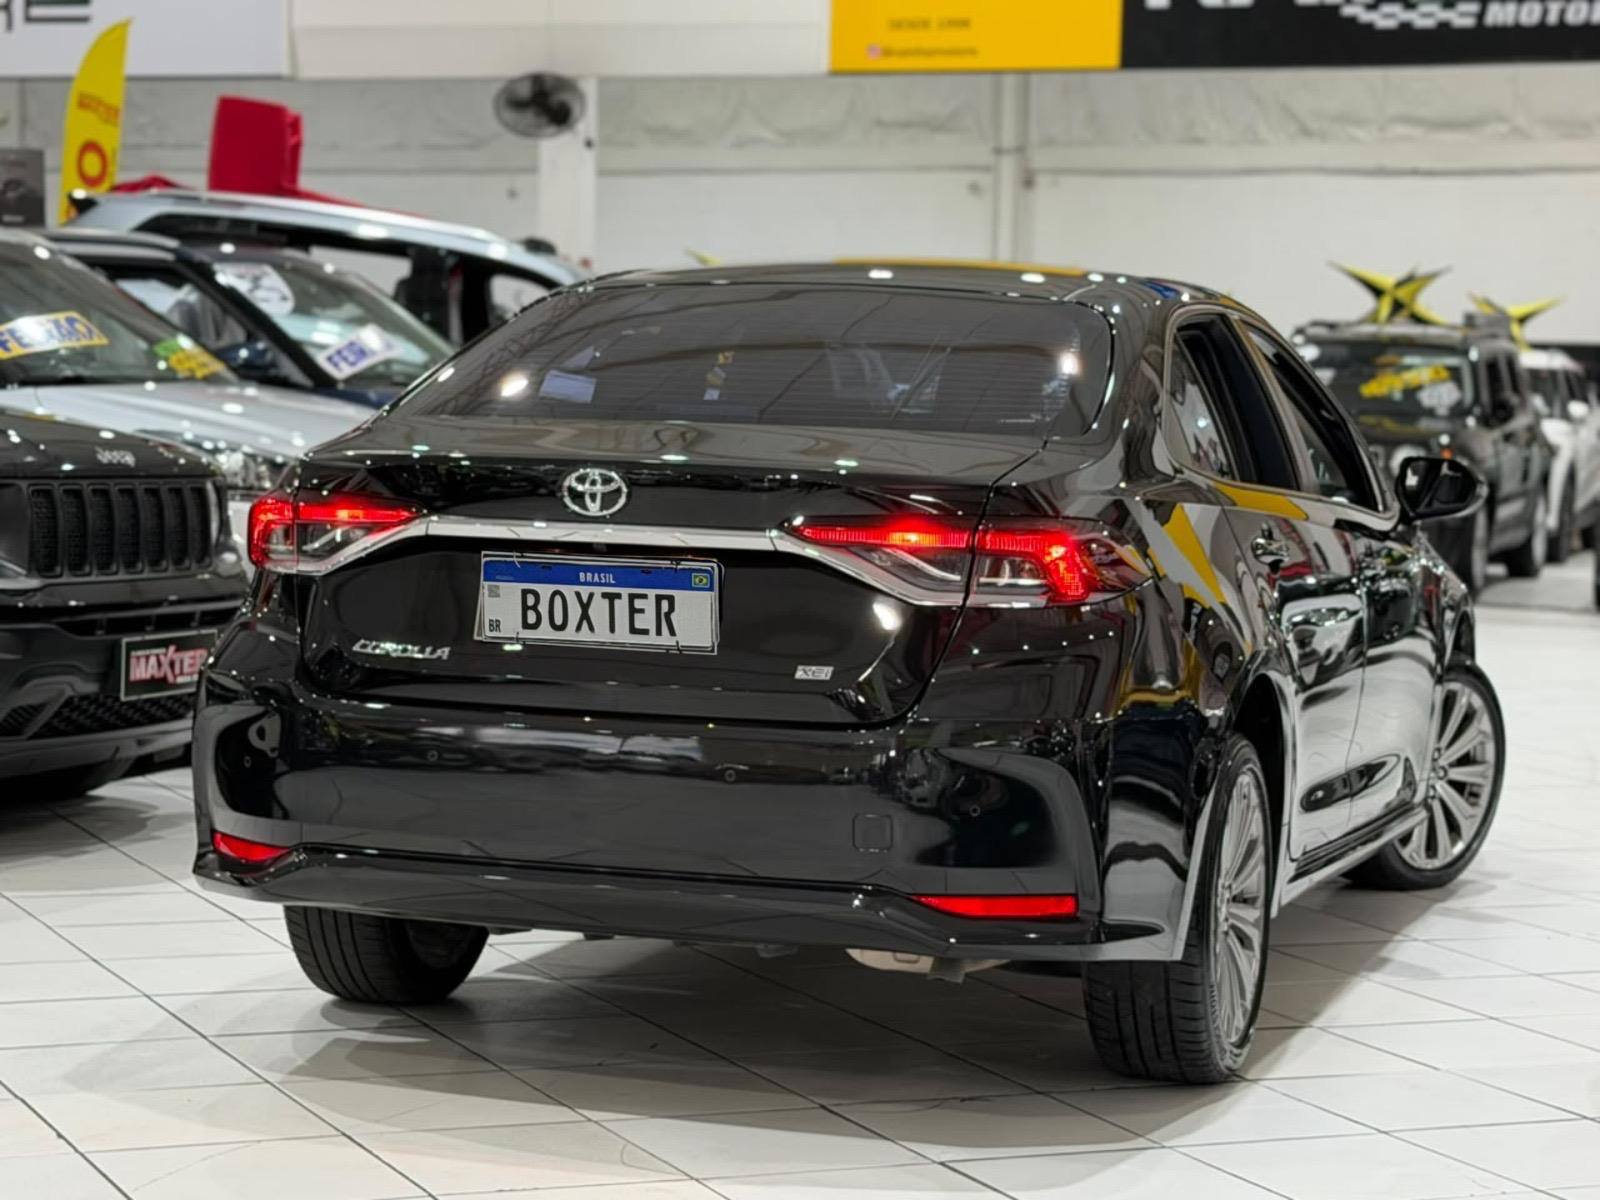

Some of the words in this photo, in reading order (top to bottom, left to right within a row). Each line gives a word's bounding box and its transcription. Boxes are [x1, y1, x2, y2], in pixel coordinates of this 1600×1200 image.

[579, 571, 616, 584] BRASIL
[521, 588, 677, 637] BOXTER
[488, 618, 501, 632] BR
[352, 638, 451, 660] COROLLA
